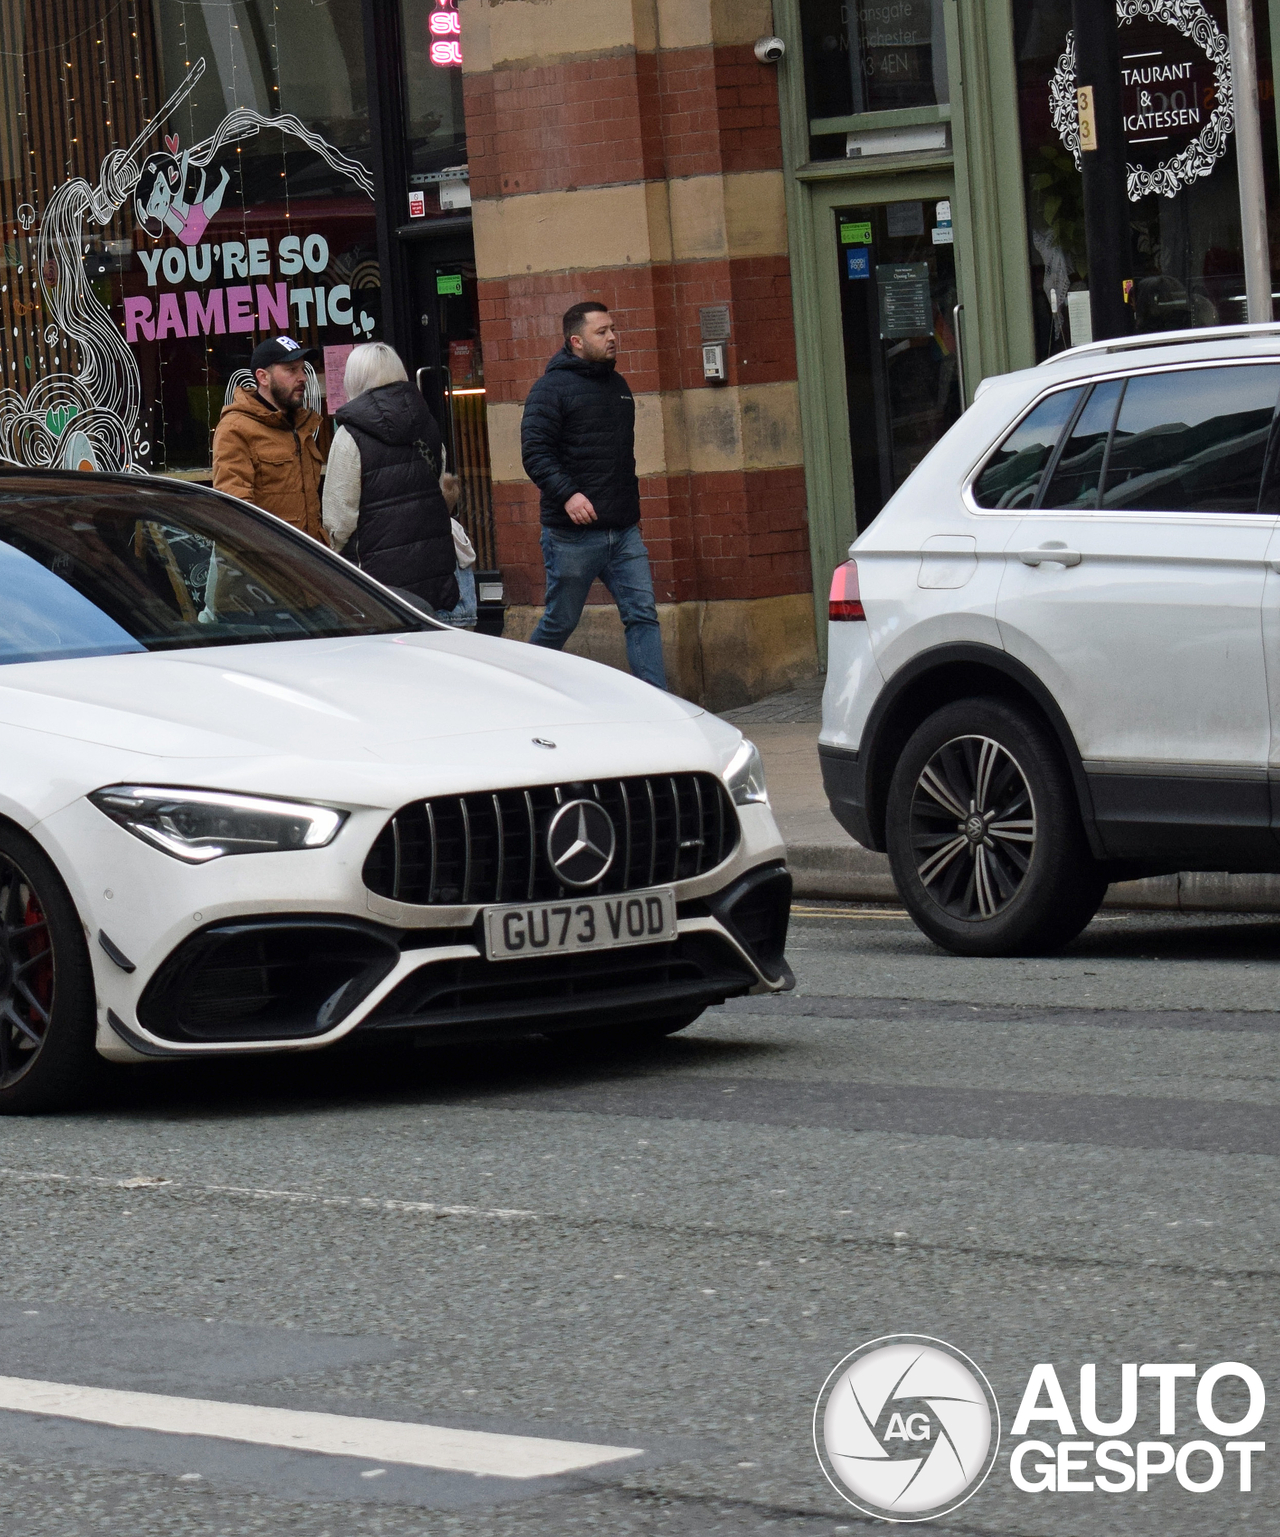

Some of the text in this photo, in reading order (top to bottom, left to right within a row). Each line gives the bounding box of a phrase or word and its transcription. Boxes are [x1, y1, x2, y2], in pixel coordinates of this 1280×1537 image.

[840, 2, 912, 24] Dansgate
[839, 27, 917, 51] Mnchester
[880, 53, 908, 74] 4EN
[1121, 62, 1193, 86] TAURANT
[1140, 90, 1152, 107] &
[1123, 108, 1200, 132] ICATESSEN
[137, 233, 329, 287] YOU'RE SO
[123, 282, 355, 343] RAMENTIC
[502, 896, 664, 951] GU73 VOD
